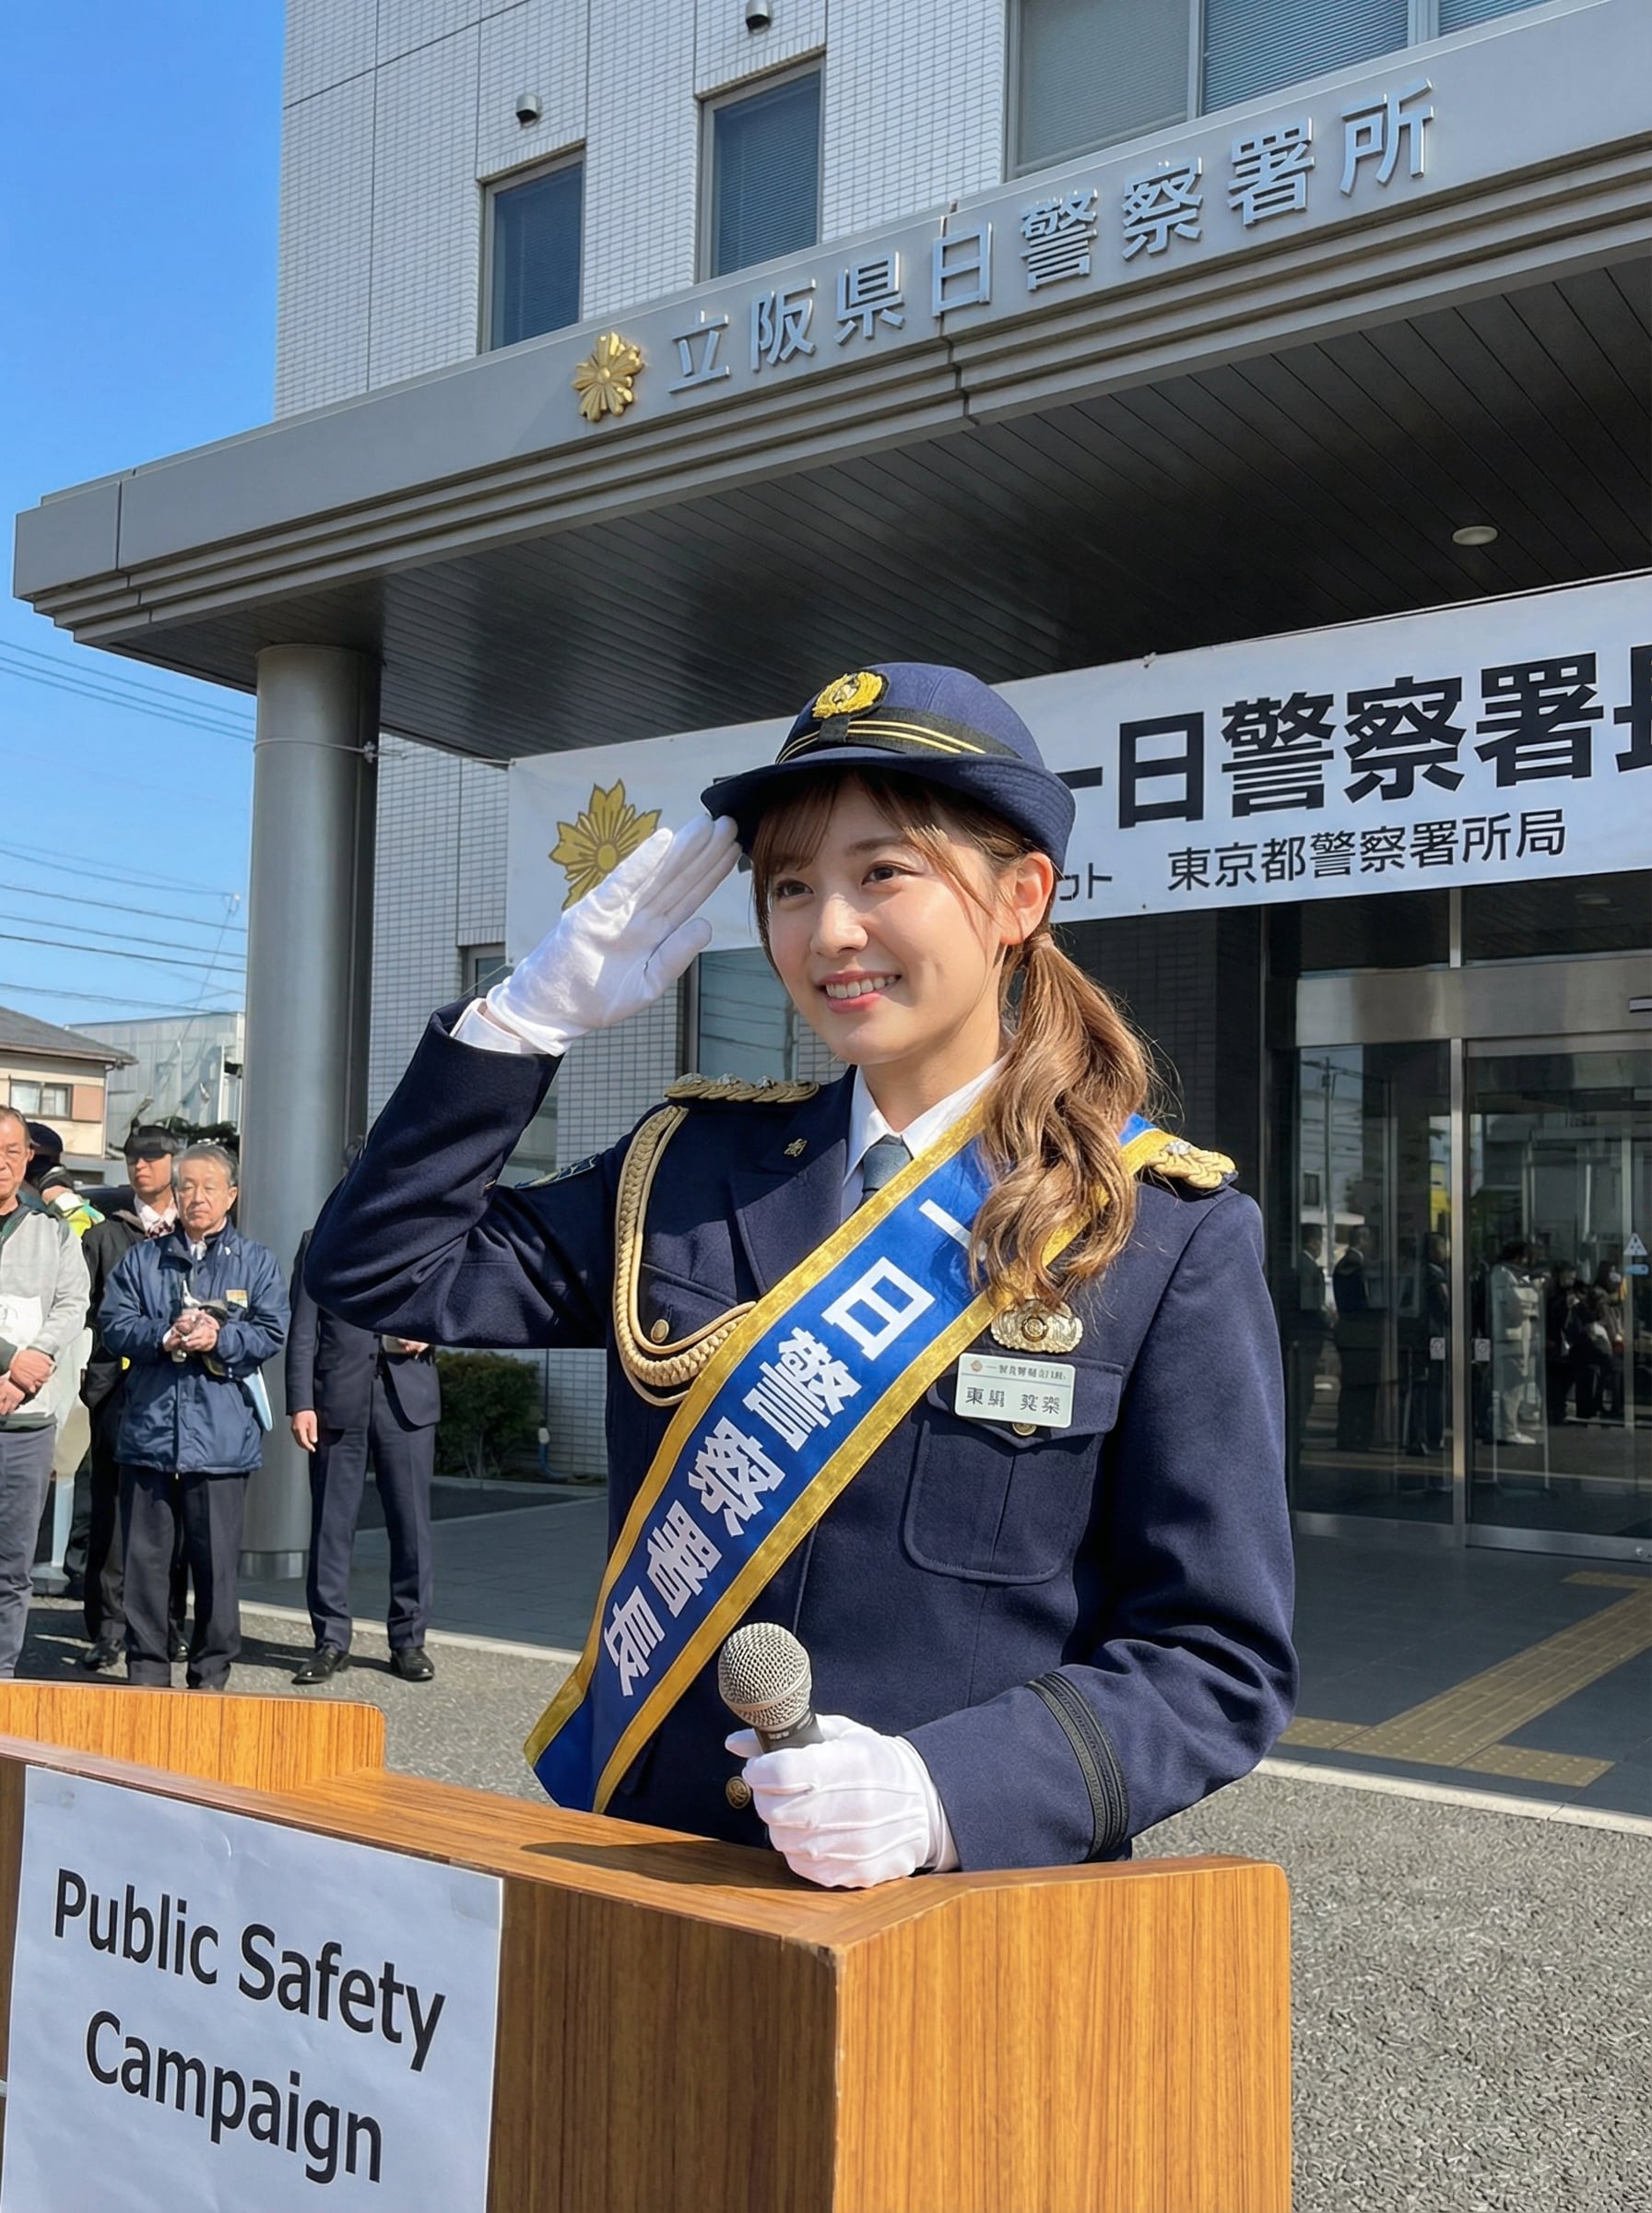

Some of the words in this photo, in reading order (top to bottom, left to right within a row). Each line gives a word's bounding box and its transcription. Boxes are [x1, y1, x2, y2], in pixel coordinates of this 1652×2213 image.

[667, 77, 1434, 395] 立阪県日警察署所
[1166, 808, 1566, 893] 東京都警察署所局
[53, 1867, 218, 1985] Public
[237, 1923, 446, 2072] Safety
[86, 2010, 383, 2184] Campaign
